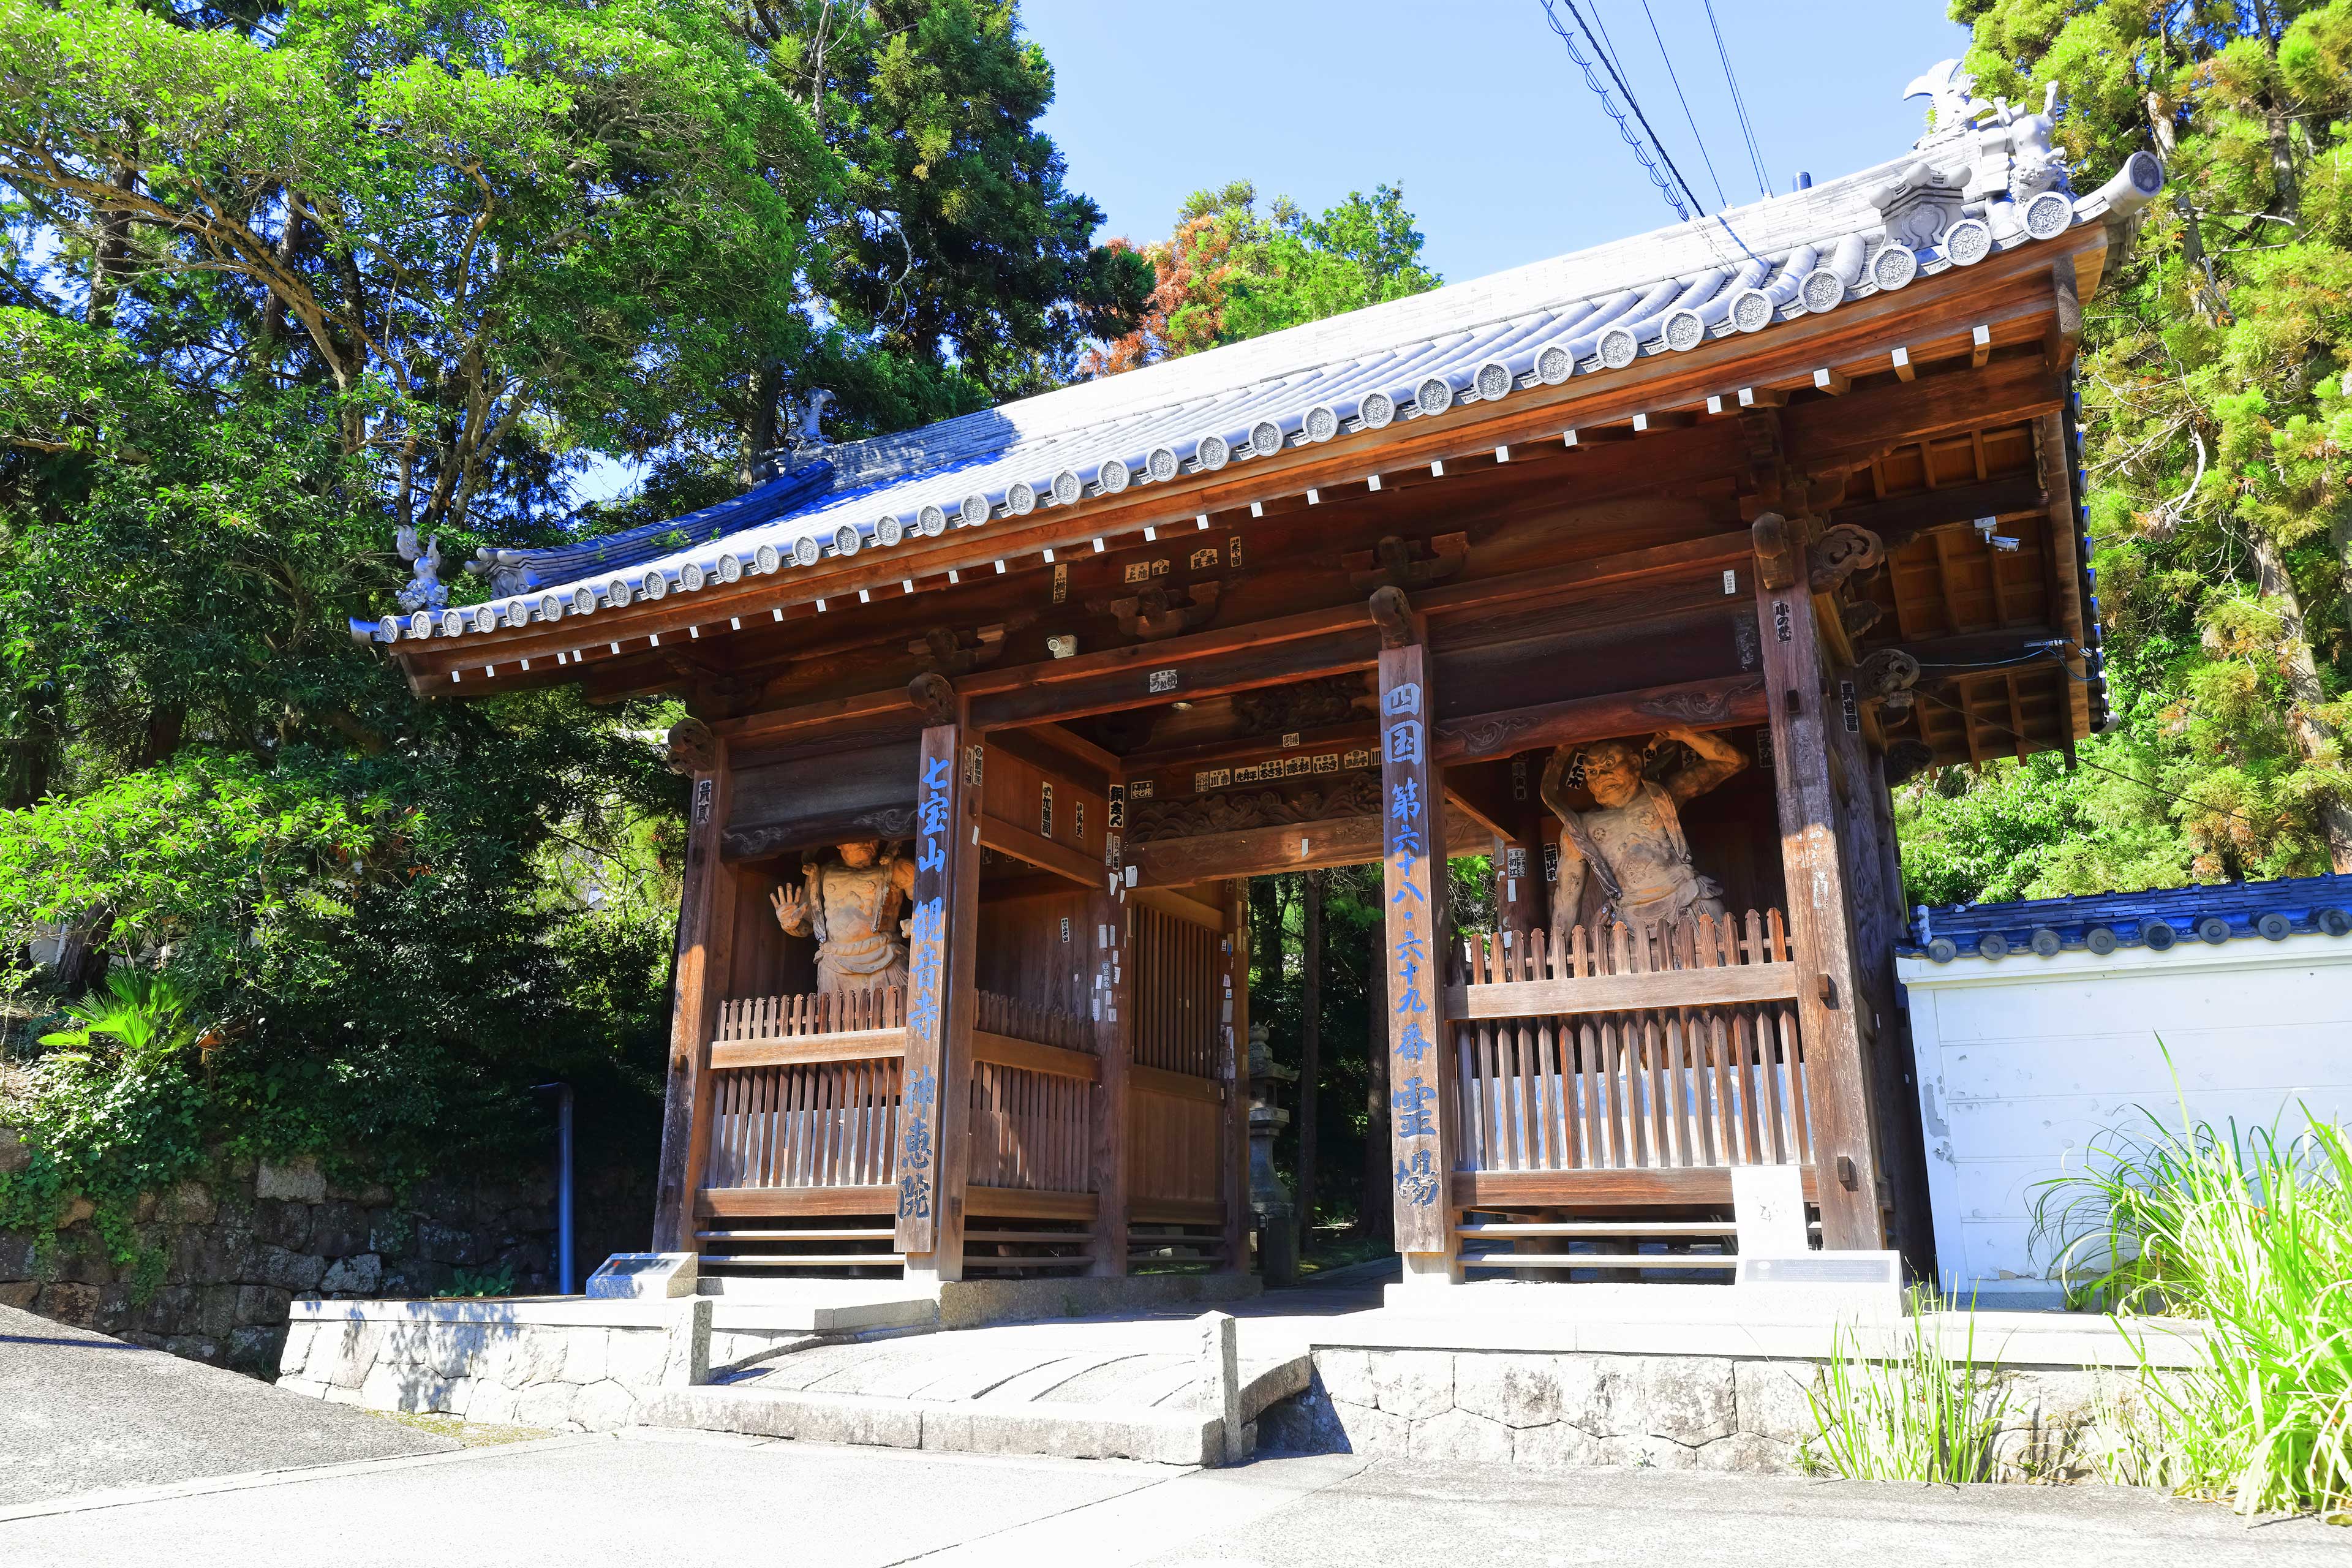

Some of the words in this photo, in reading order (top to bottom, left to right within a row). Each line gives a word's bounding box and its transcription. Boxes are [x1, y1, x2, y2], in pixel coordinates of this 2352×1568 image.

[918, 756, 949, 873] 七宝山
[908, 896, 944, 1041] 観音寺
[899, 1065, 936, 1219] 神恵院
